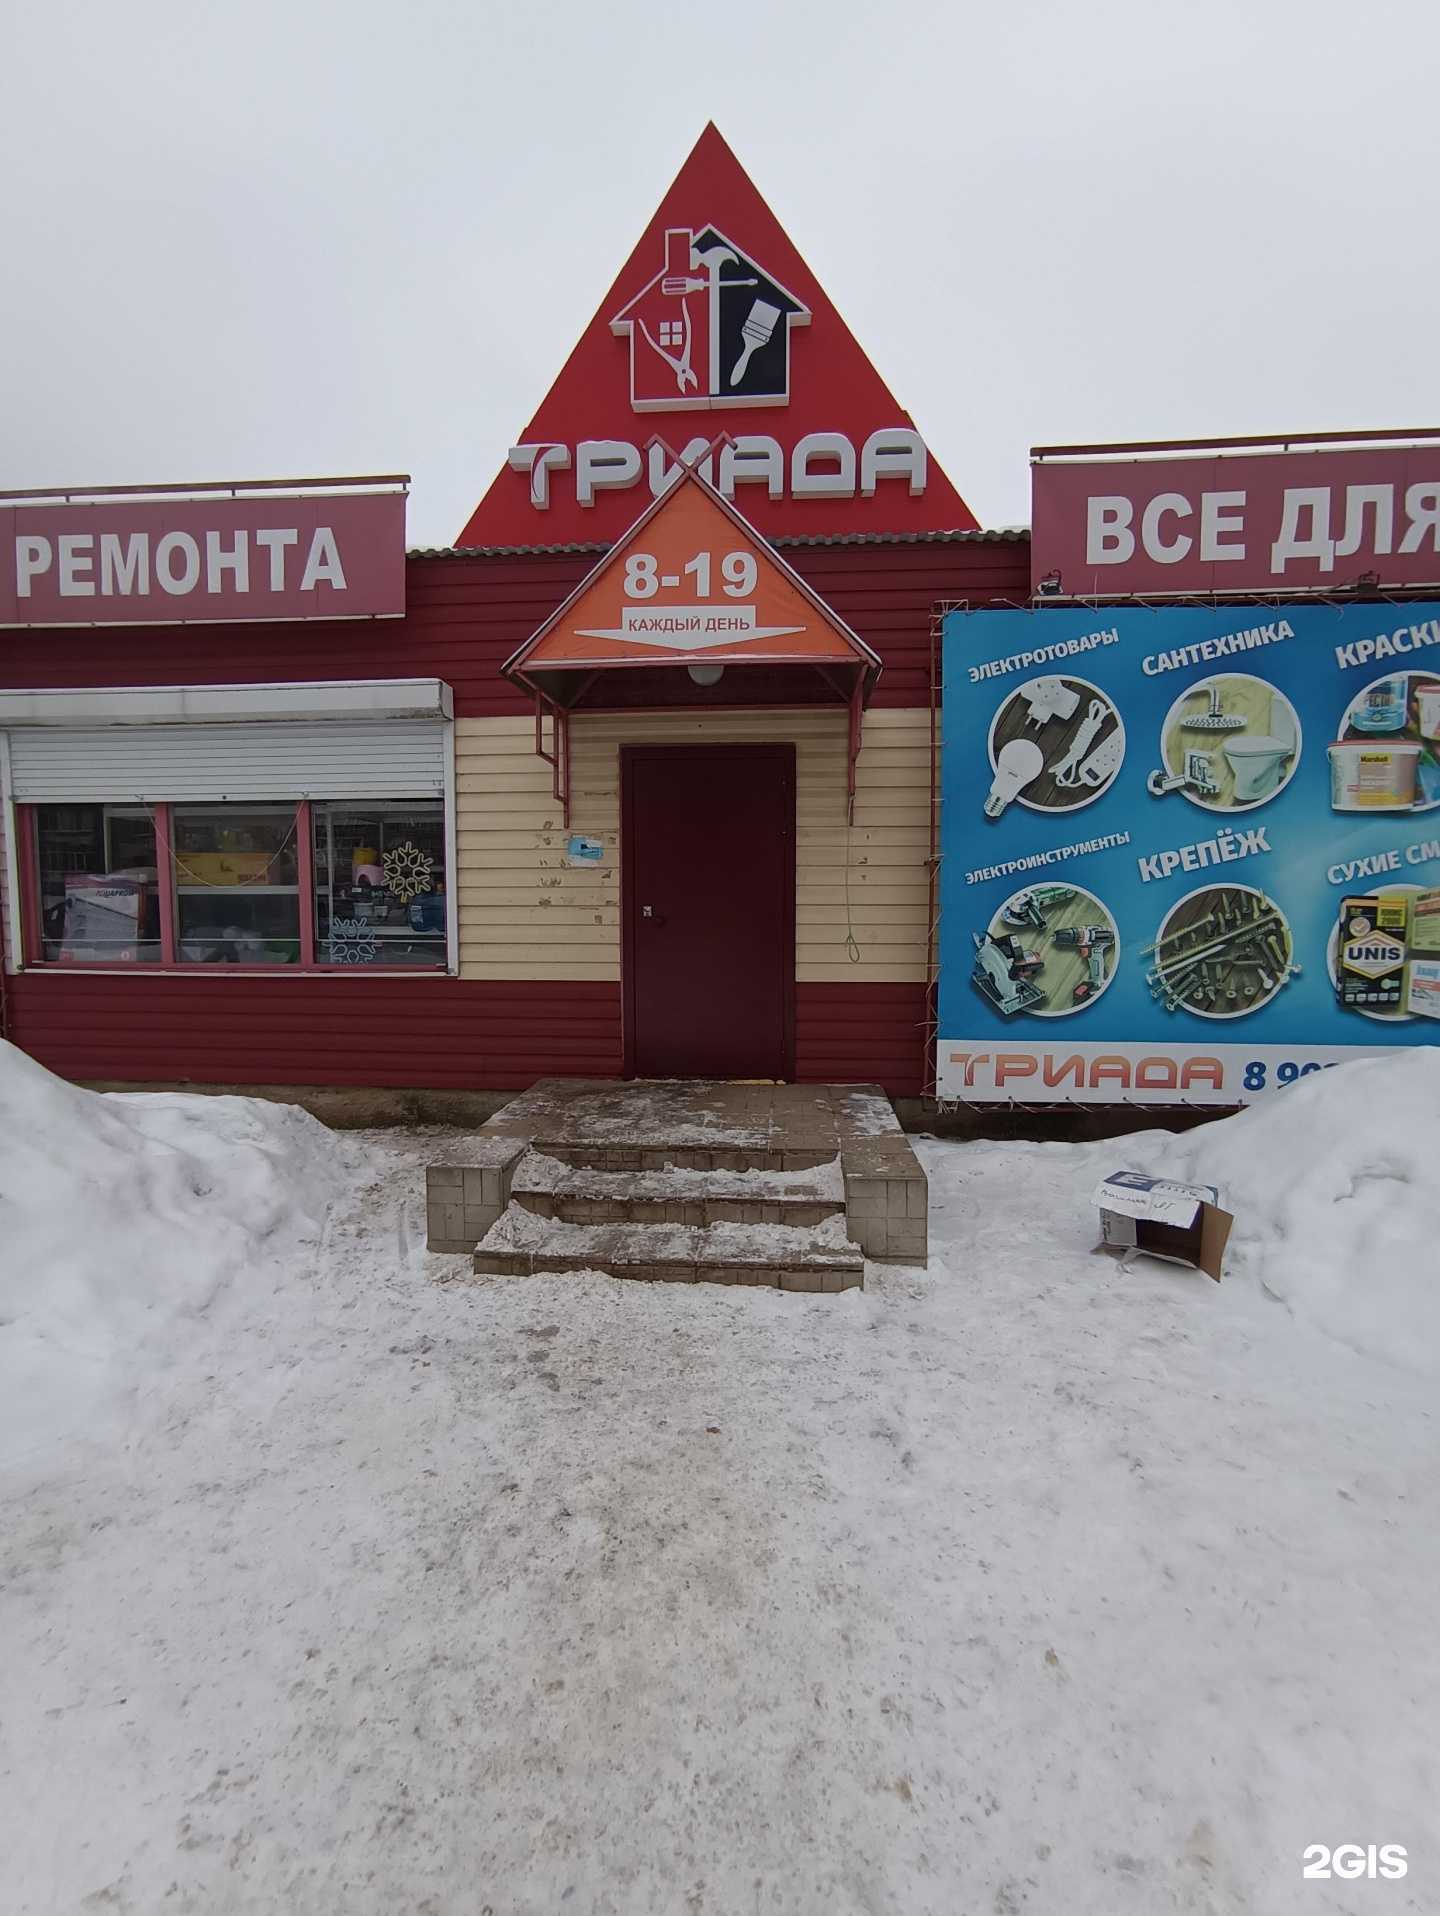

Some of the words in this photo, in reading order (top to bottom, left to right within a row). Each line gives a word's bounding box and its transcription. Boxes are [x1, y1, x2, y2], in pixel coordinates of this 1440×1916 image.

[509, 428, 927, 510] ТРИАДА
[1087, 490, 1246, 565] ВСЕ
[1270, 482, 1440, 574] ДЛЯ
[15, 527, 347, 597] РЕМОНТА
[623, 551, 758, 599] 8-19
[629, 616, 700, 633] КАЖДЫЙ
[705, 617, 750, 632] ДЕНЬ
[1143, 620, 1295, 676] САНТЕХНИКА
[968, 628, 1119, 683] ЭЛЕКТРОТОВАРЫ
[965, 831, 1130, 885] ЭЛЕКТРОИНСТРУМЕНТЫ
[1138, 827, 1272, 882] КРЕПЁЖ
[1327, 850, 1402, 884] СУХИЕ
[1348, 947, 1401, 961] UNIS
[950, 1054, 1224, 1089] ТРИАДА
[1243, 1061, 1266, 1091] 8
